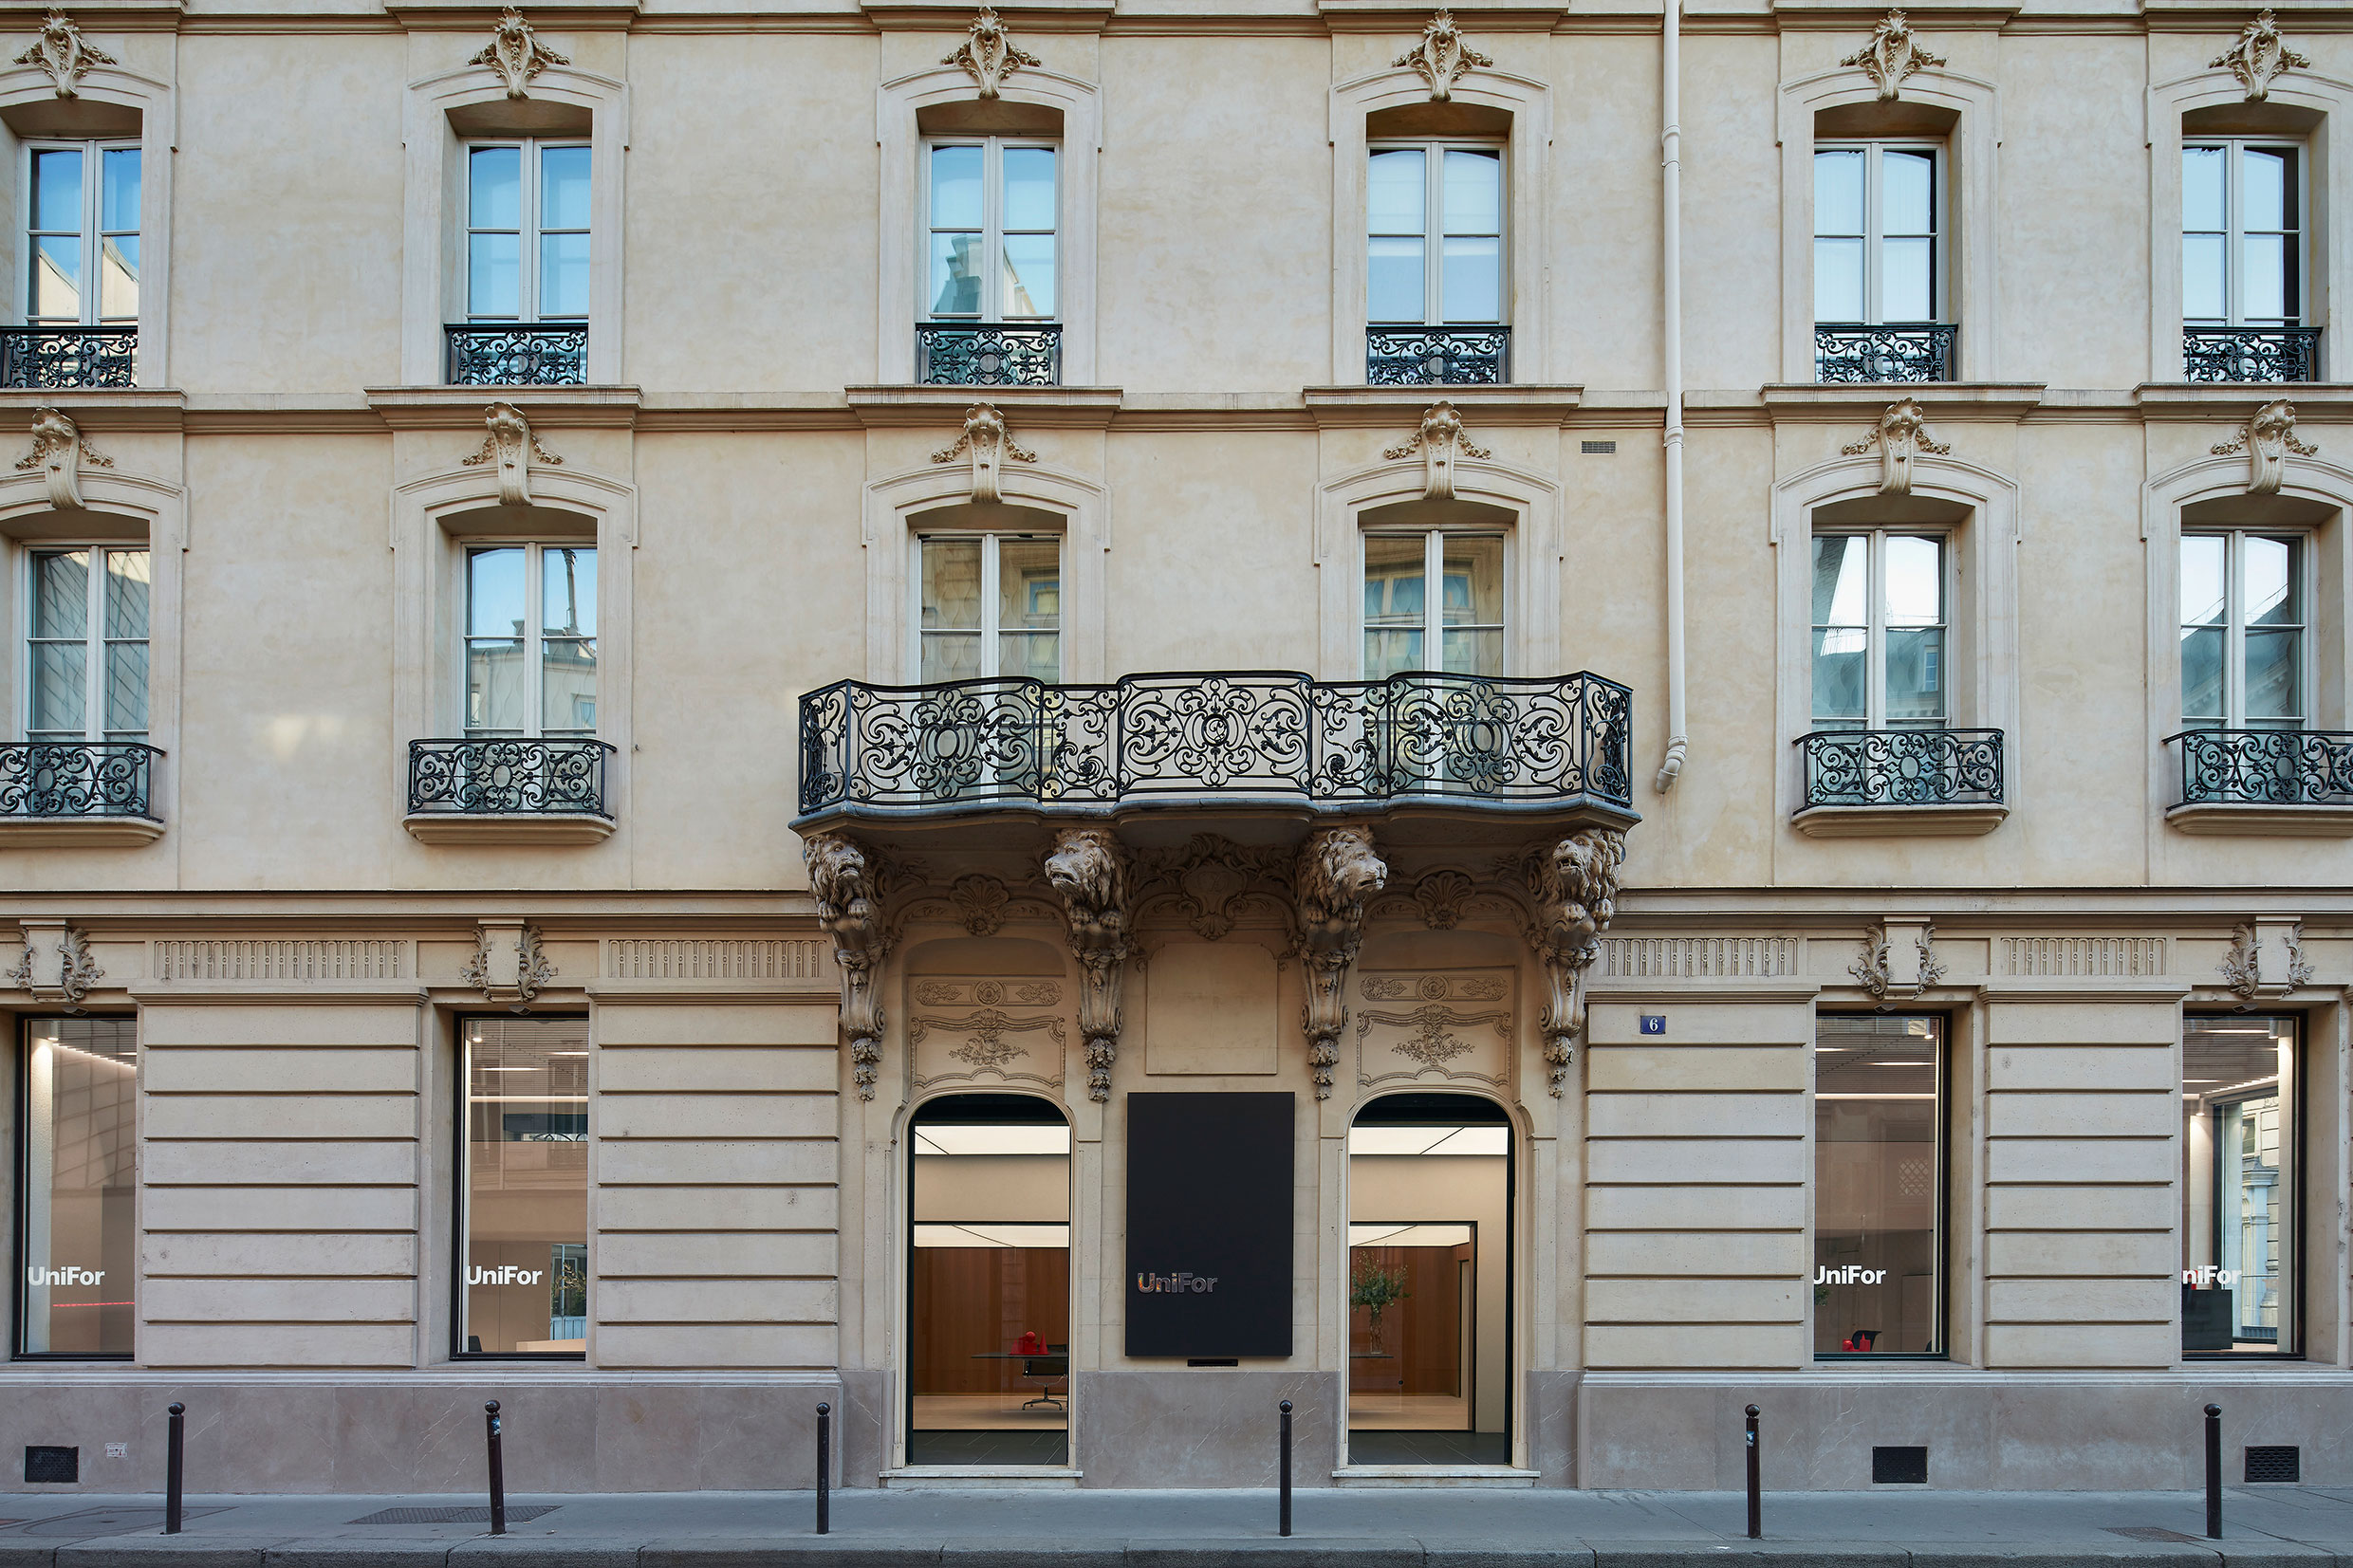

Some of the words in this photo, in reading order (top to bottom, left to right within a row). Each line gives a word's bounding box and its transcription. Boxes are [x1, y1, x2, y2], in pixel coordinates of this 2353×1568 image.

[1649, 1017, 1658, 1032] 6
[28, 1266, 105, 1286] UniFor
[465, 1265, 543, 1285] UniFor
[1138, 1272, 1218, 1293] UniFor
[2182, 1264, 2242, 1284] niFor
